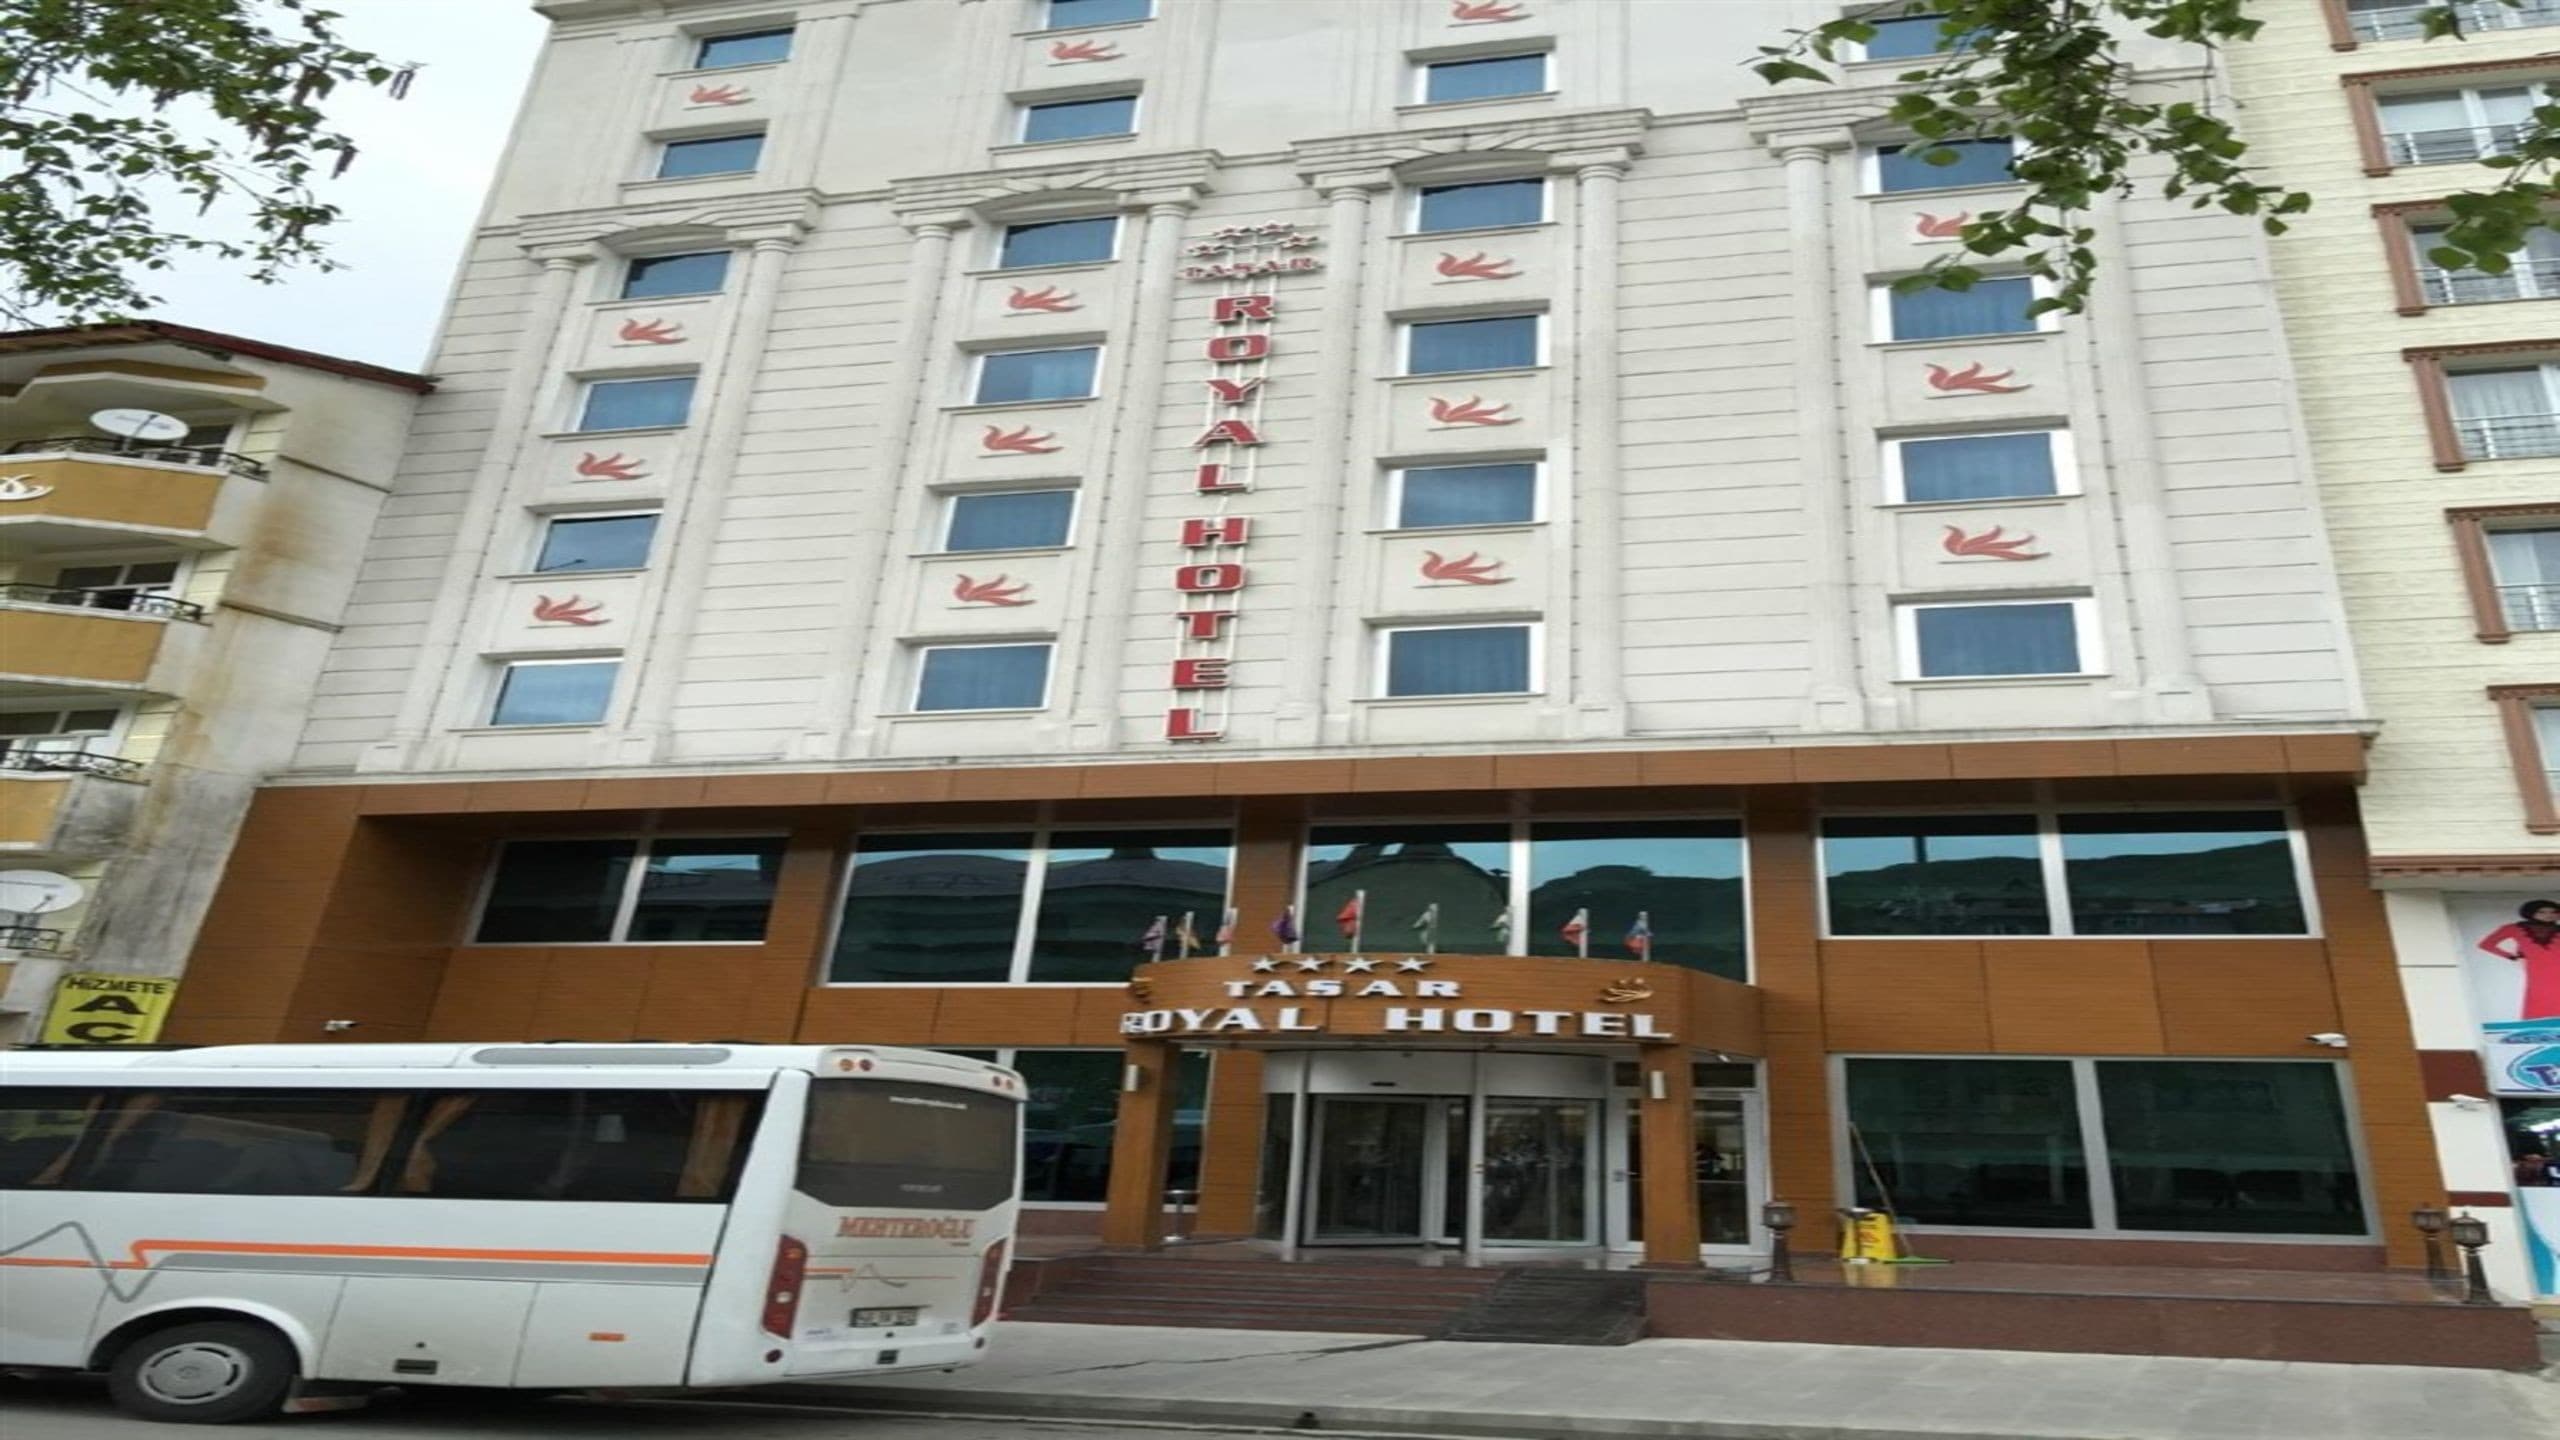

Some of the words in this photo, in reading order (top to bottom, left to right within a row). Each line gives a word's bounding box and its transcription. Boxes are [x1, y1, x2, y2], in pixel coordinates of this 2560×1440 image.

[1178, 256, 1322, 281] TASAR
[1194, 294, 1276, 494] ROYAL
[1164, 516, 1252, 743] HOTEL
[1223, 978, 1461, 999] TASAR
[1119, 1007, 1319, 1034] ROYAL
[1384, 1007, 1672, 1038] HOTEL
